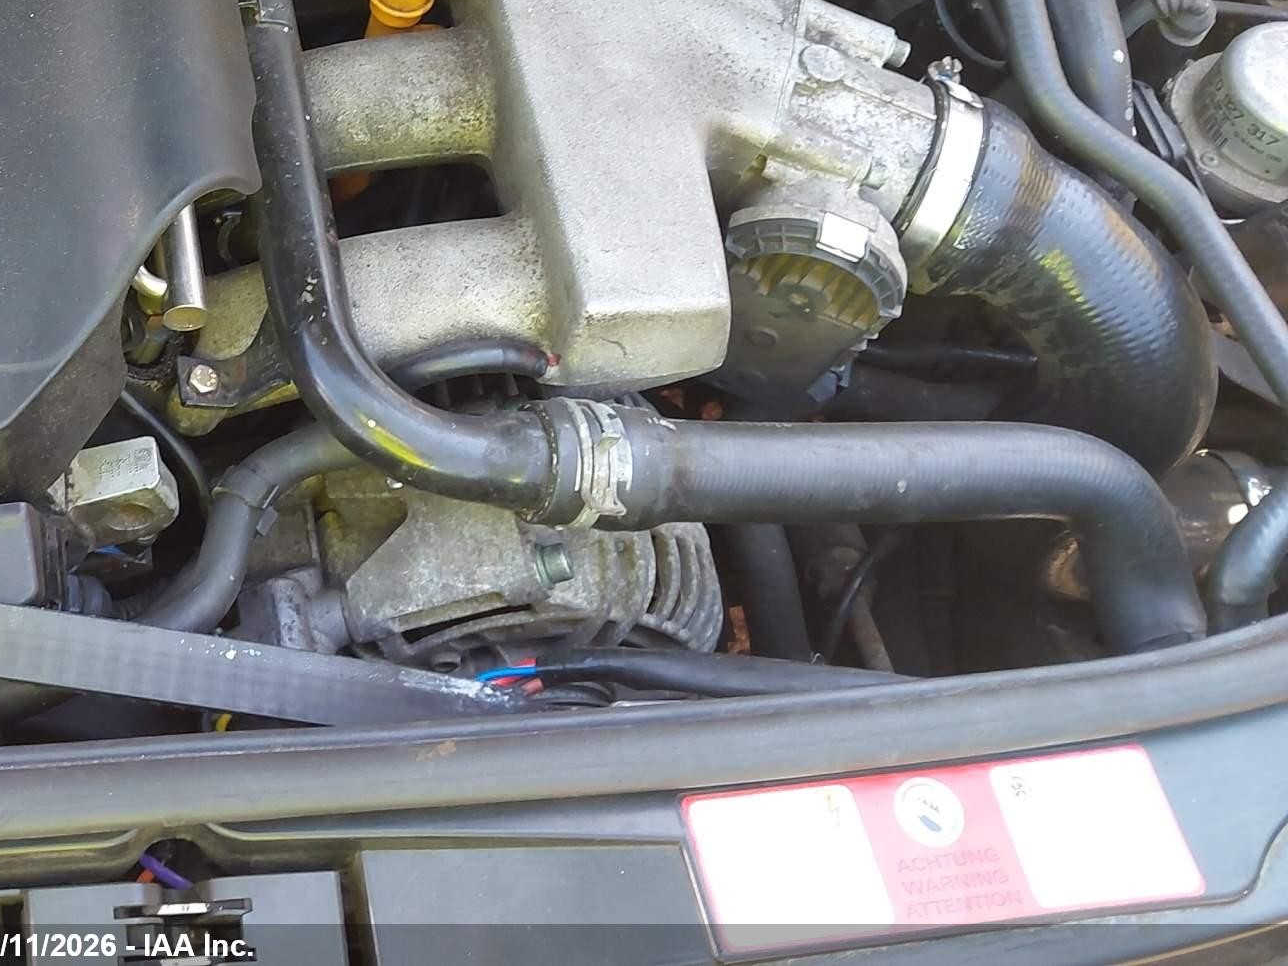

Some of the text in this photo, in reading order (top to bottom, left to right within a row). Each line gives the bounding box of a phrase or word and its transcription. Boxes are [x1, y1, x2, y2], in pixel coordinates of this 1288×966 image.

[897, 847, 1001, 874] ACHTUNG
[900, 868, 1010, 896] WARNING
[906, 890, 1026, 920] ATTENTION
